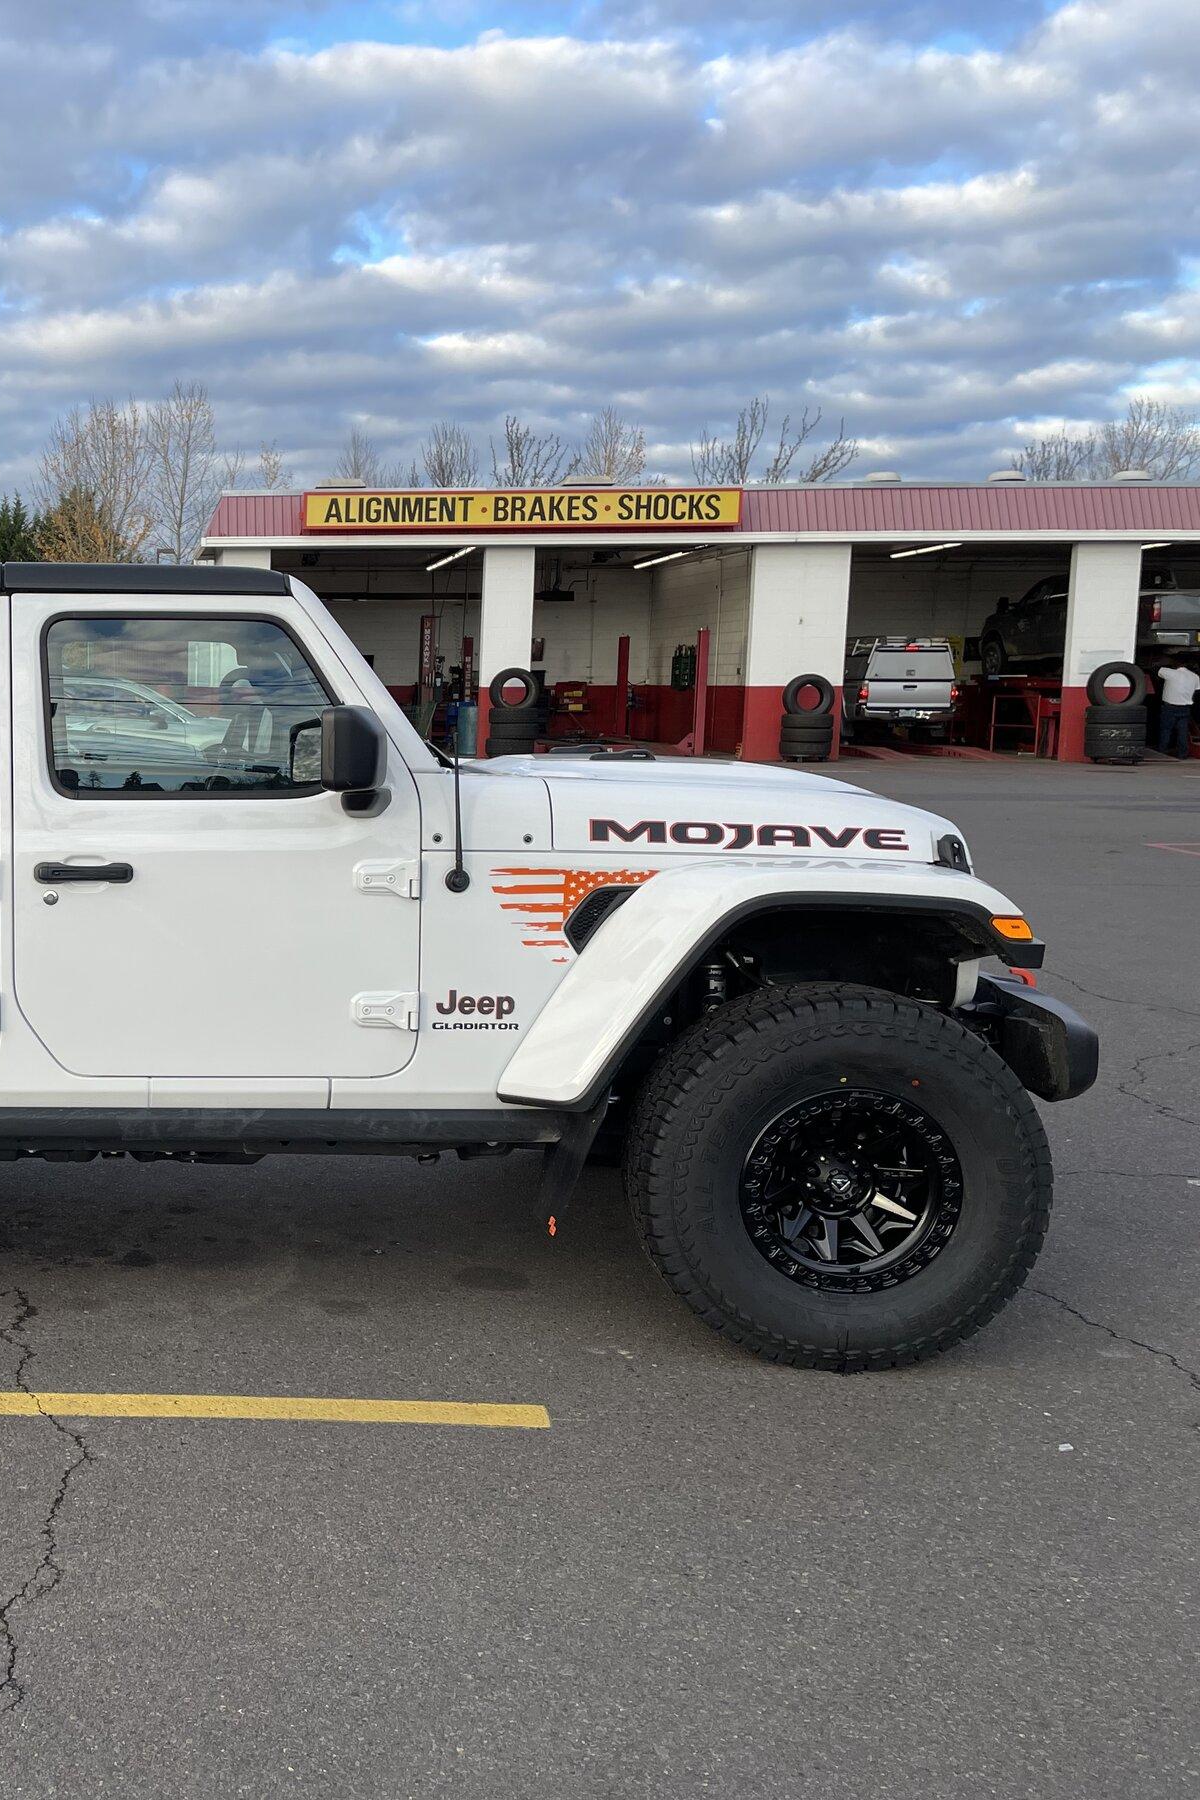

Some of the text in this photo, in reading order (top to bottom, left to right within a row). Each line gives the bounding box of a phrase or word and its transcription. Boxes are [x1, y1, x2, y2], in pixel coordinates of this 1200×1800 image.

[324, 494, 721, 523] ALIGNMENT BRAKES SHOCKS
[589, 818, 910, 851] MOJAVE
[436, 989, 515, 1020] Jeep
[432, 1022, 519, 1031] GLADIATOR
